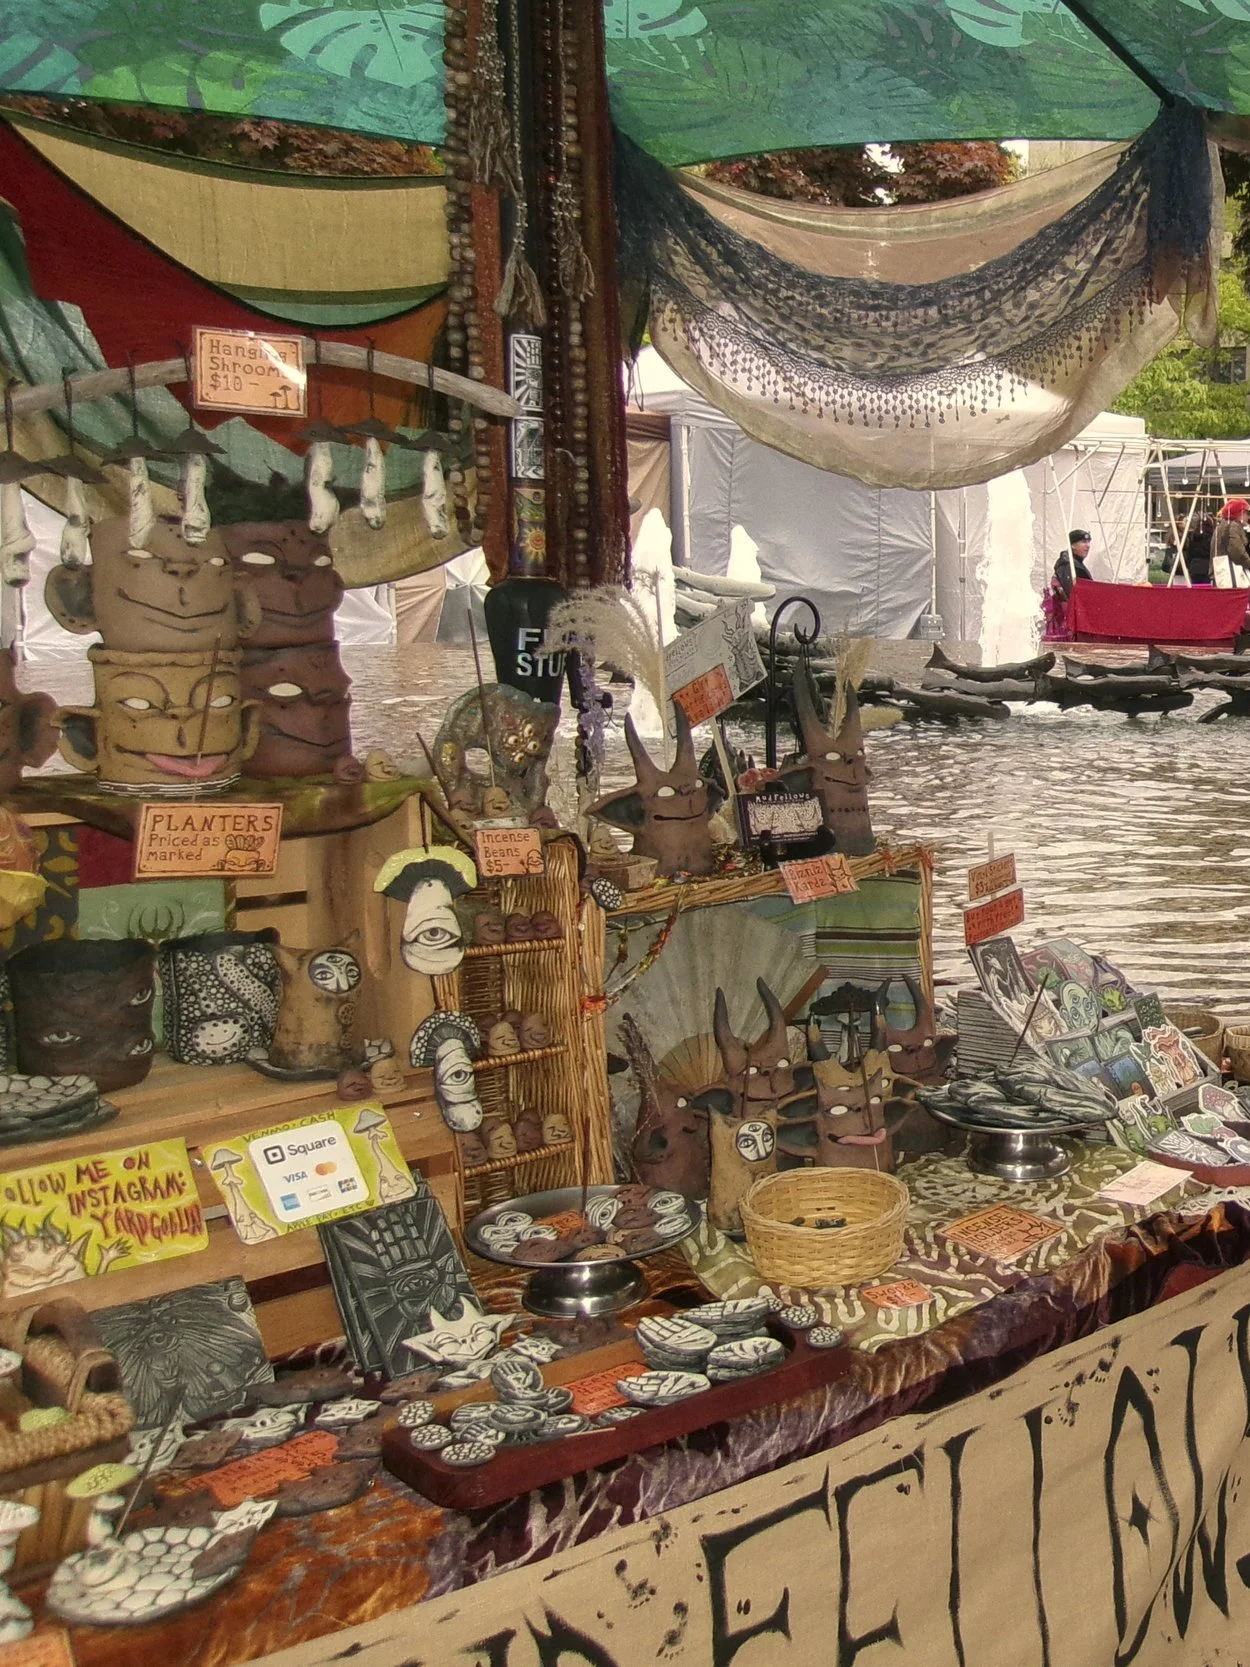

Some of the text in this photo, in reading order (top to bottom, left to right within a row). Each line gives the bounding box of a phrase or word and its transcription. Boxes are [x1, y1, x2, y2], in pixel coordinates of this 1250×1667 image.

[208, 339, 287, 363] Hangig
[208, 356, 289, 379] Shroom
[151, 814, 274, 832] PLANTERS
[148, 833, 220, 847] Priced as
[481, 832, 530, 843] Incense
[146, 848, 203, 861] marked
[483, 846, 520, 858] Beans
[300, 1111, 336, 1128] CASH
[287, 1135, 337, 1157] Square
[4, 1151, 151, 1206] OLLOW ME ON
[283, 1171, 309, 1184] VISA
[952, 1212, 1008, 1239] INCENSE
[967, 1217, 1023, 1244] HOLDERS
